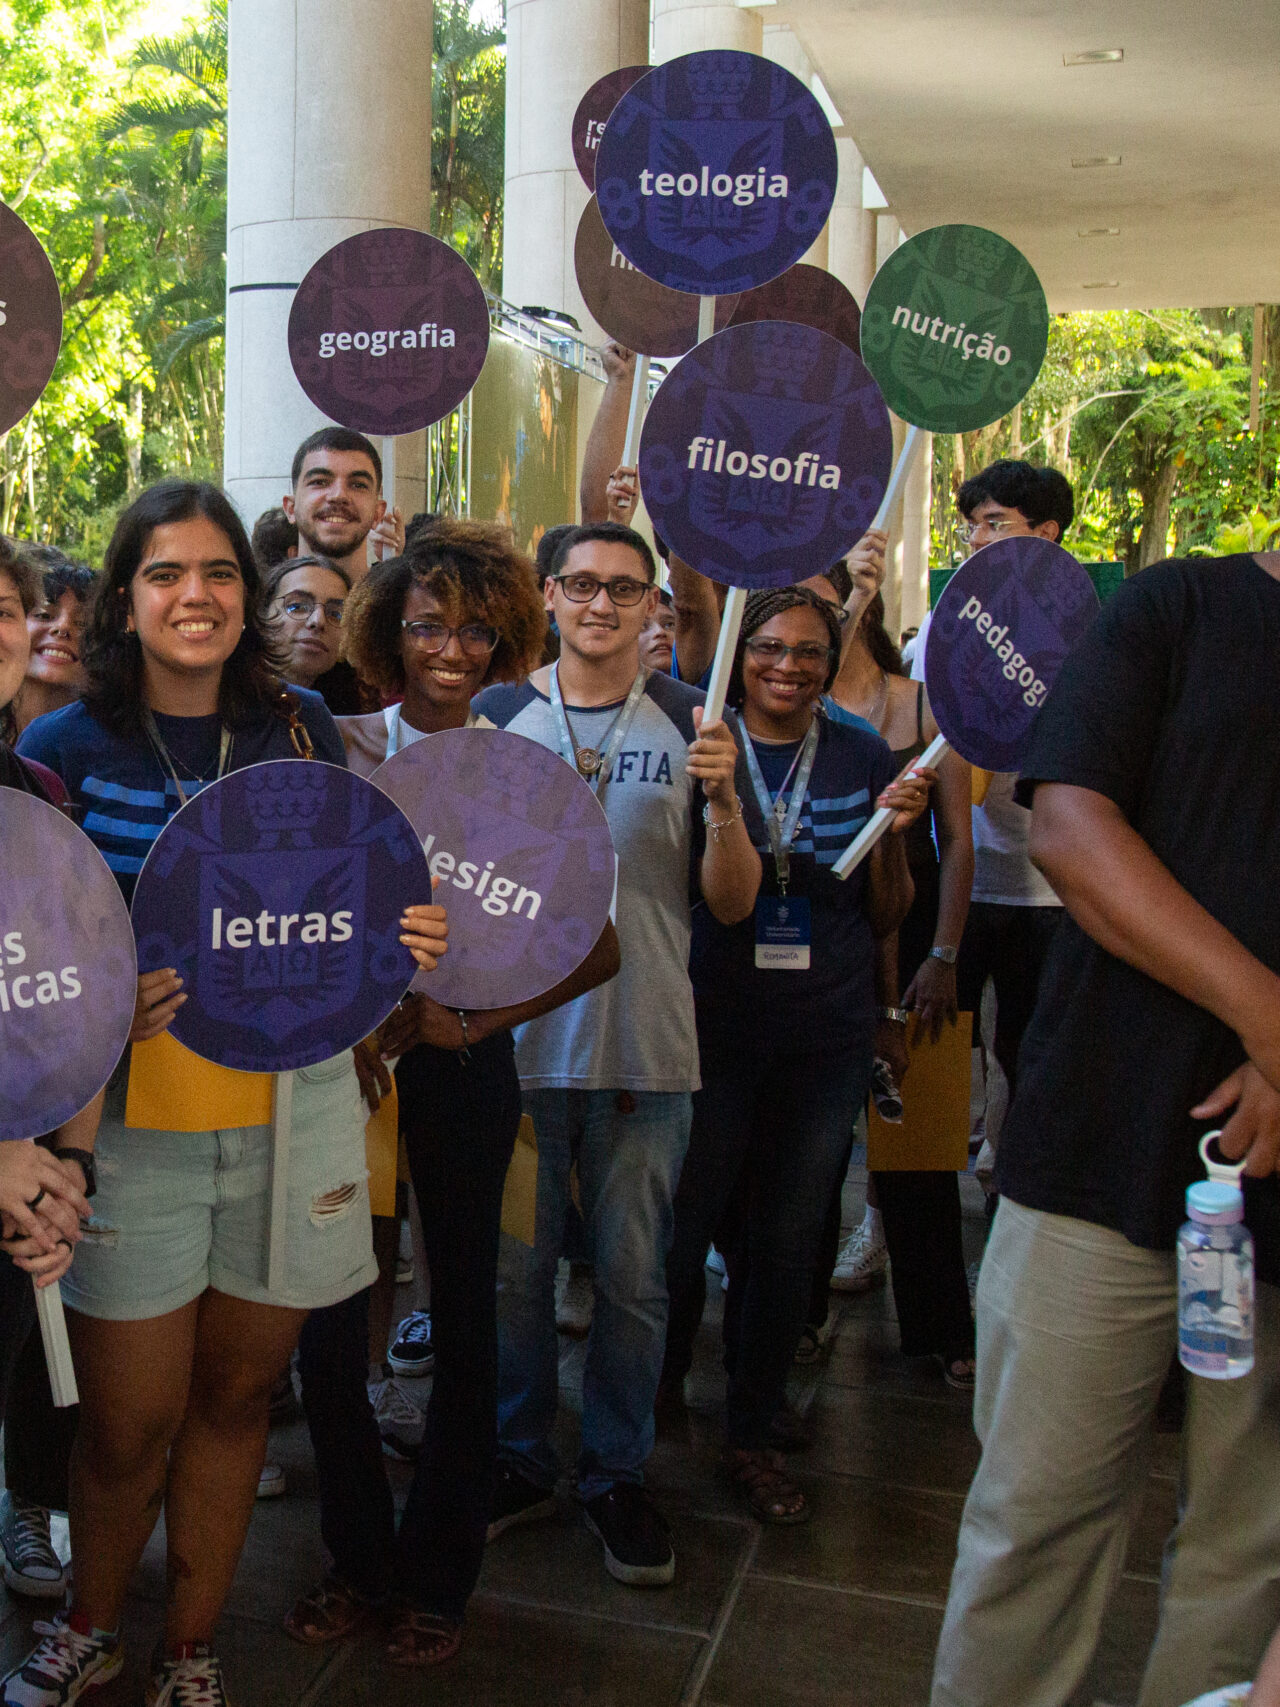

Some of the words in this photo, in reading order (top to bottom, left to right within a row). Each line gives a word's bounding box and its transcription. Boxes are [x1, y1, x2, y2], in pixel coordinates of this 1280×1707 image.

[638, 166, 788, 206] teologia
[318, 322, 456, 359] geografia
[891, 304, 1011, 367] nutrição
[687, 436, 841, 490] filosofia
[211, 907, 354, 950] letras
